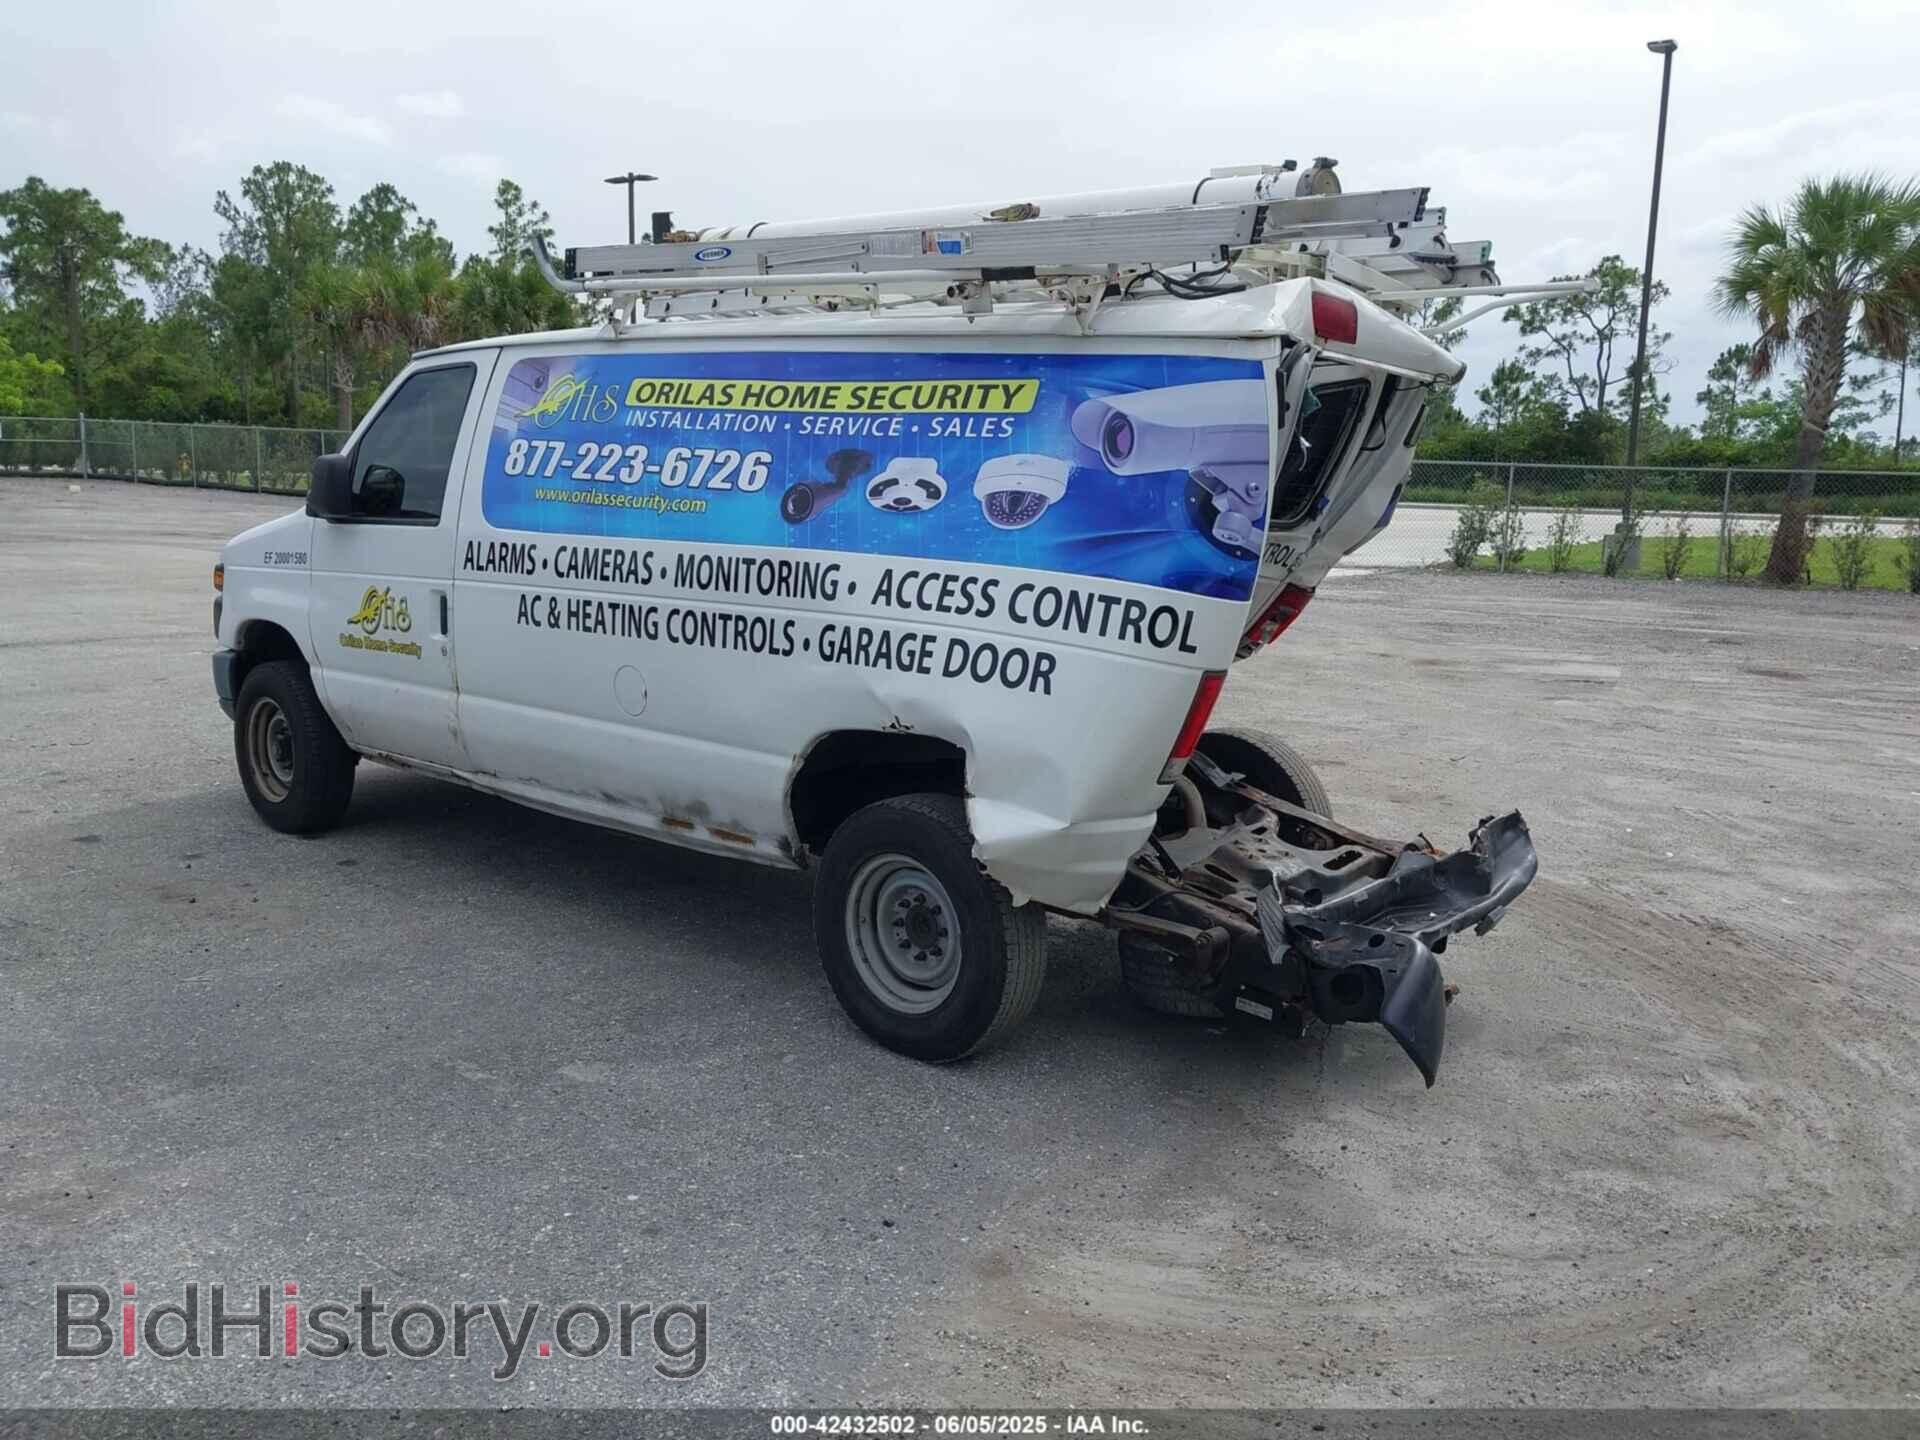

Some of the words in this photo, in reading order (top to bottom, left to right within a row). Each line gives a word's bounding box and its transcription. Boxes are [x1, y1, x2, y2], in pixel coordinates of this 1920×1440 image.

[635, 381, 736, 408] ORILAS
[739, 383, 842, 411] HOME
[845, 383, 1027, 411] SECURITY
[624, 409, 778, 434] INSTALLATION
[798, 415, 904, 437] SERVICE
[928, 416, 1017, 439] SALES
[503, 437, 774, 494] 877-223-6726
[534, 486, 708, 517] www.orilassecurity.com
[463, 539, 538, 576] ALARMS
[553, 544, 655, 586] CAMERAS
[673, 552, 842, 602] MONITORING
[870, 567, 1001, 619] ACCESS
[1007, 582, 1200, 655] CONTROL
[516, 593, 542, 628] AC
[546, 595, 562, 630] &
[566, 597, 660, 641] HEATING
[665, 608, 797, 658] CONTROLS
[818, 623, 938, 675] GARAGE
[941, 637, 1058, 696] DOOR
